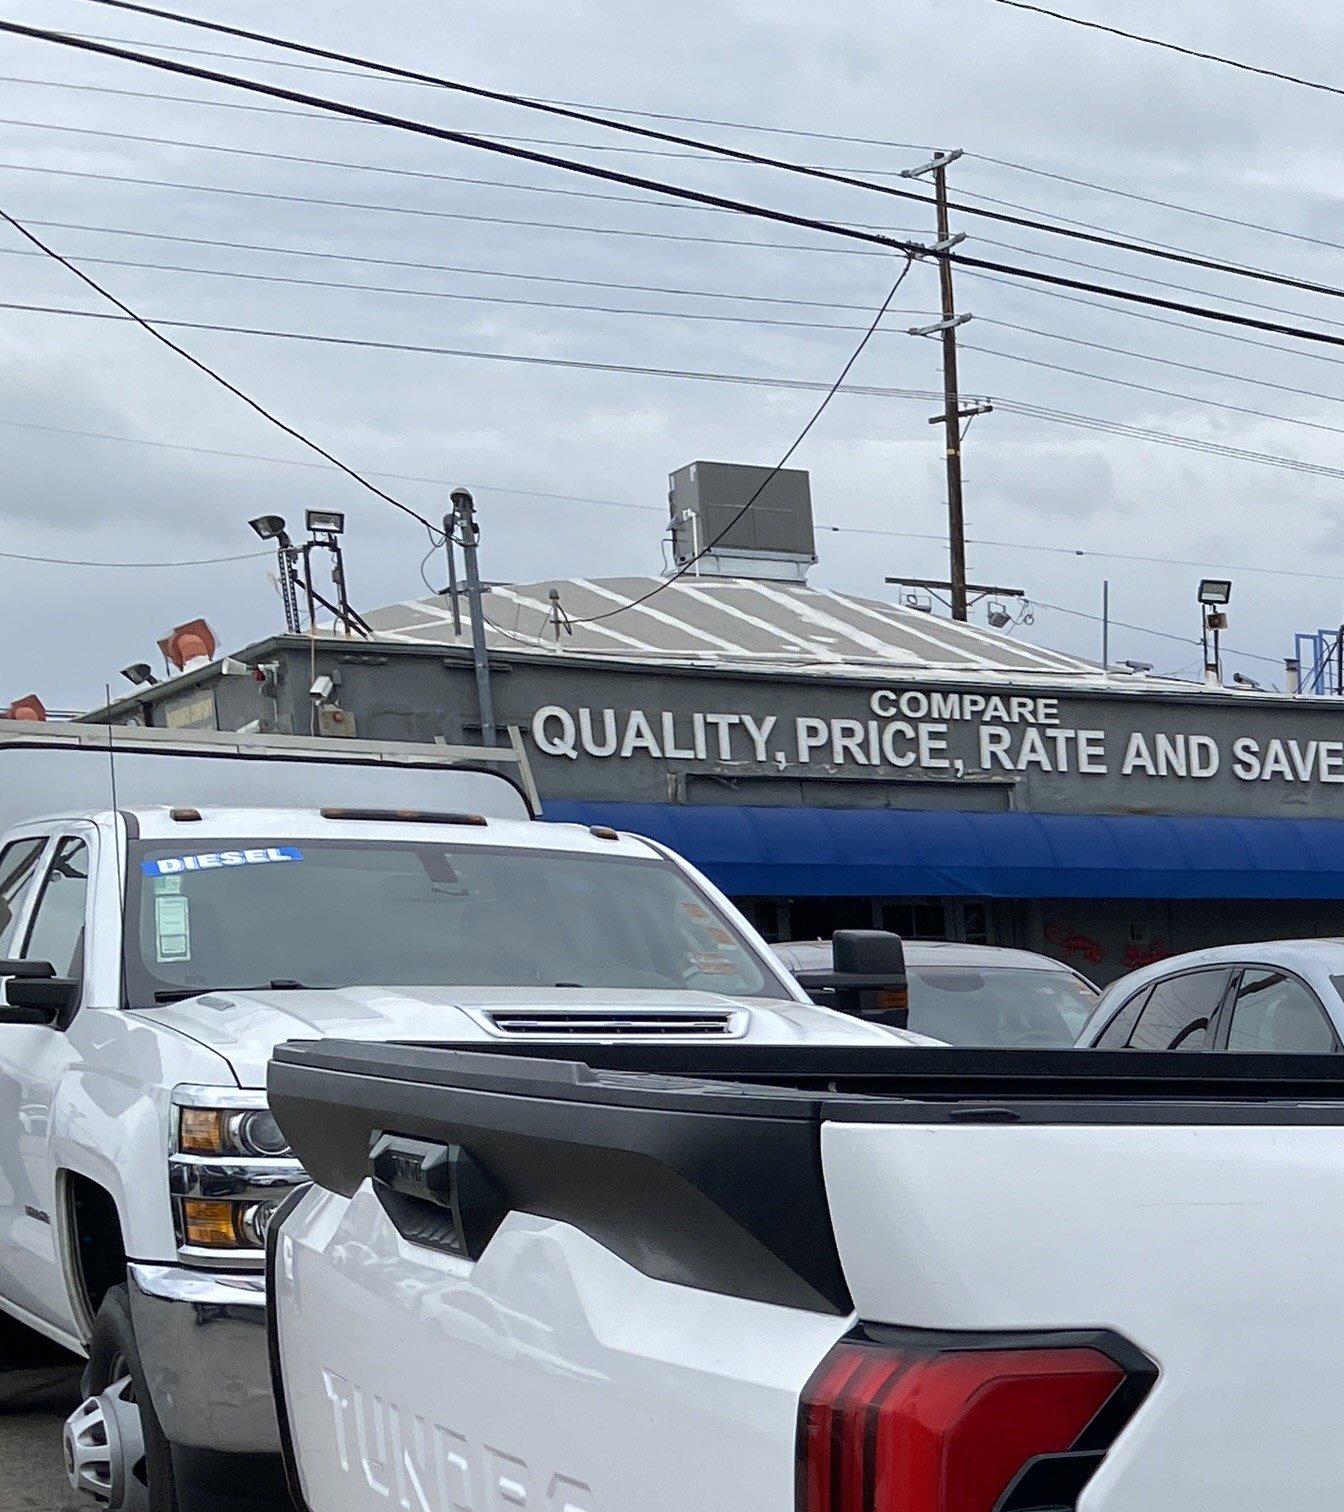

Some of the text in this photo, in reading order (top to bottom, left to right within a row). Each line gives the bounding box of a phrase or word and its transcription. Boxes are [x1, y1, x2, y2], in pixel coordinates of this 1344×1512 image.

[869, 689, 1060, 725] COMPARE
[532, 705, 788, 772] QUALITY,
[797, 716, 967, 778] PRICE,
[979, 723, 1108, 775] RATE
[1121, 731, 1220, 780] AND
[156, 848, 292, 874] DIESEL
